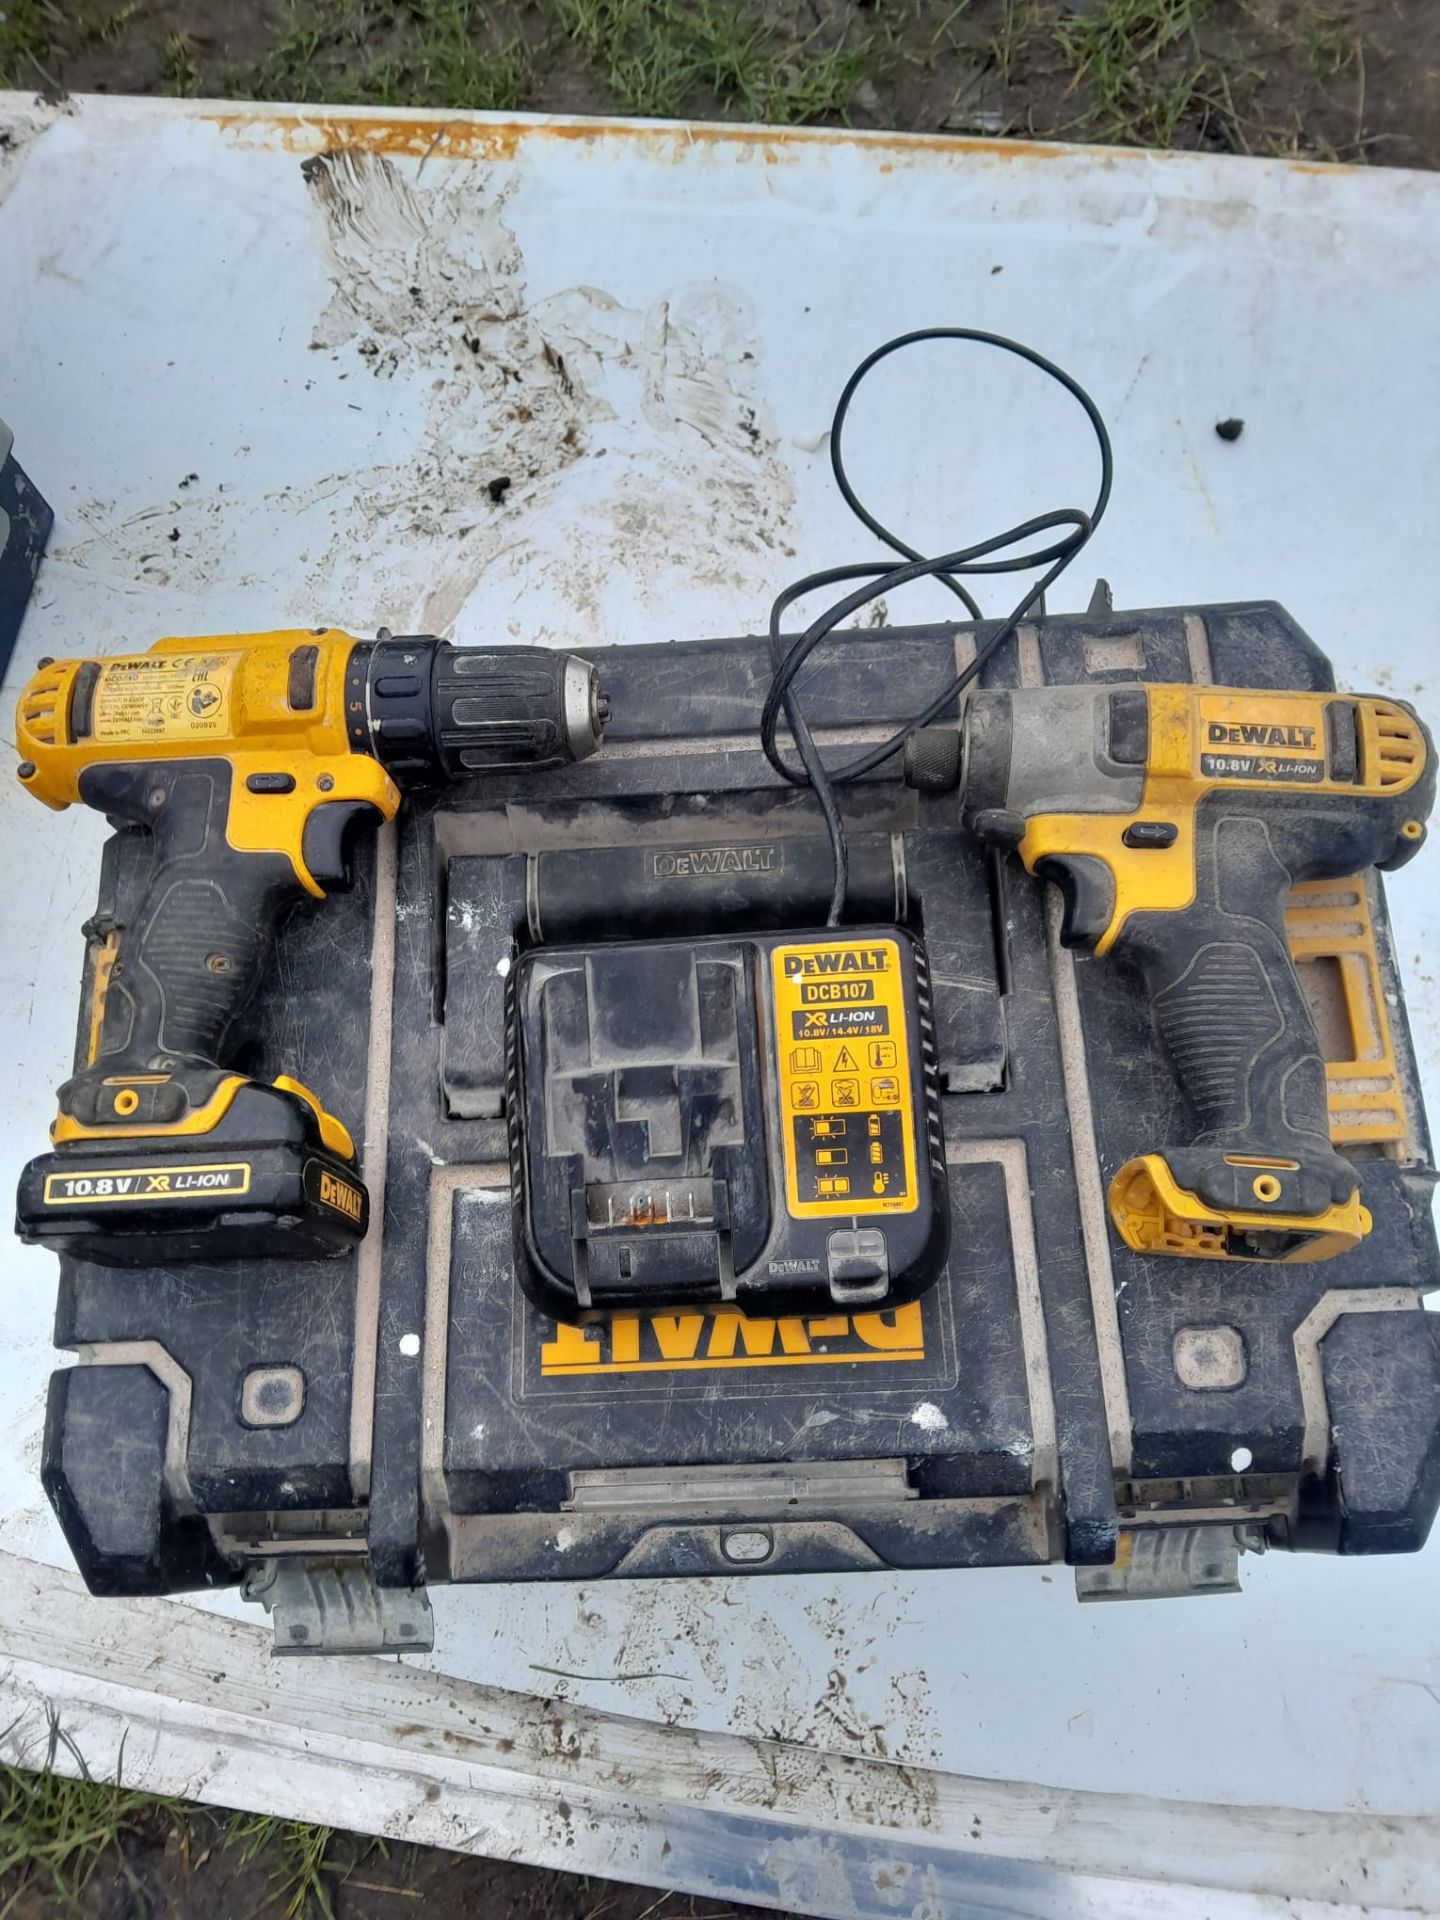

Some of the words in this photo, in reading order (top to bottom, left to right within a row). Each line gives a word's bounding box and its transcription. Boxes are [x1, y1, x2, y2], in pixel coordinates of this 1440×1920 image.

[1278, 764, 1318, 774] LI-ION
[806, 982, 868, 1001] DCB107
[829, 1010, 876, 1024] LI-ION
[174, 1172, 230, 1189] LI-ION
